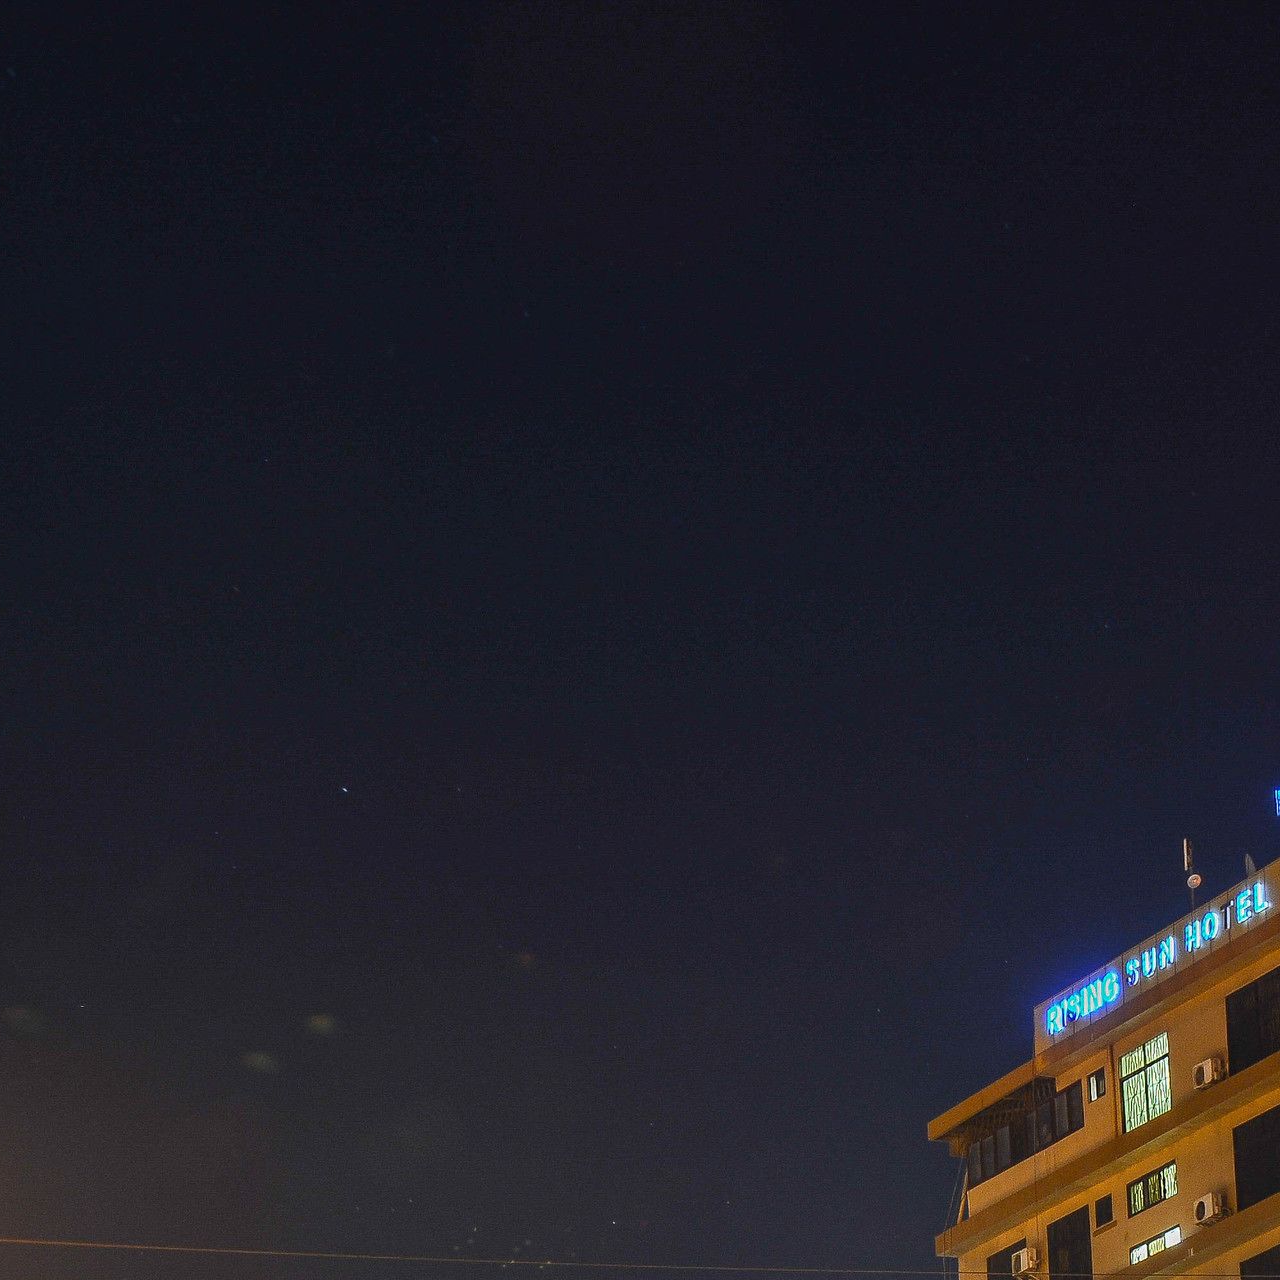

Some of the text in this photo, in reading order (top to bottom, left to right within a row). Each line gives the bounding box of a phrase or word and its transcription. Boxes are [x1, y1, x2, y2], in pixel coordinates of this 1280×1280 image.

[1046, 882, 1270, 1034] RISING SUN HOTEL
